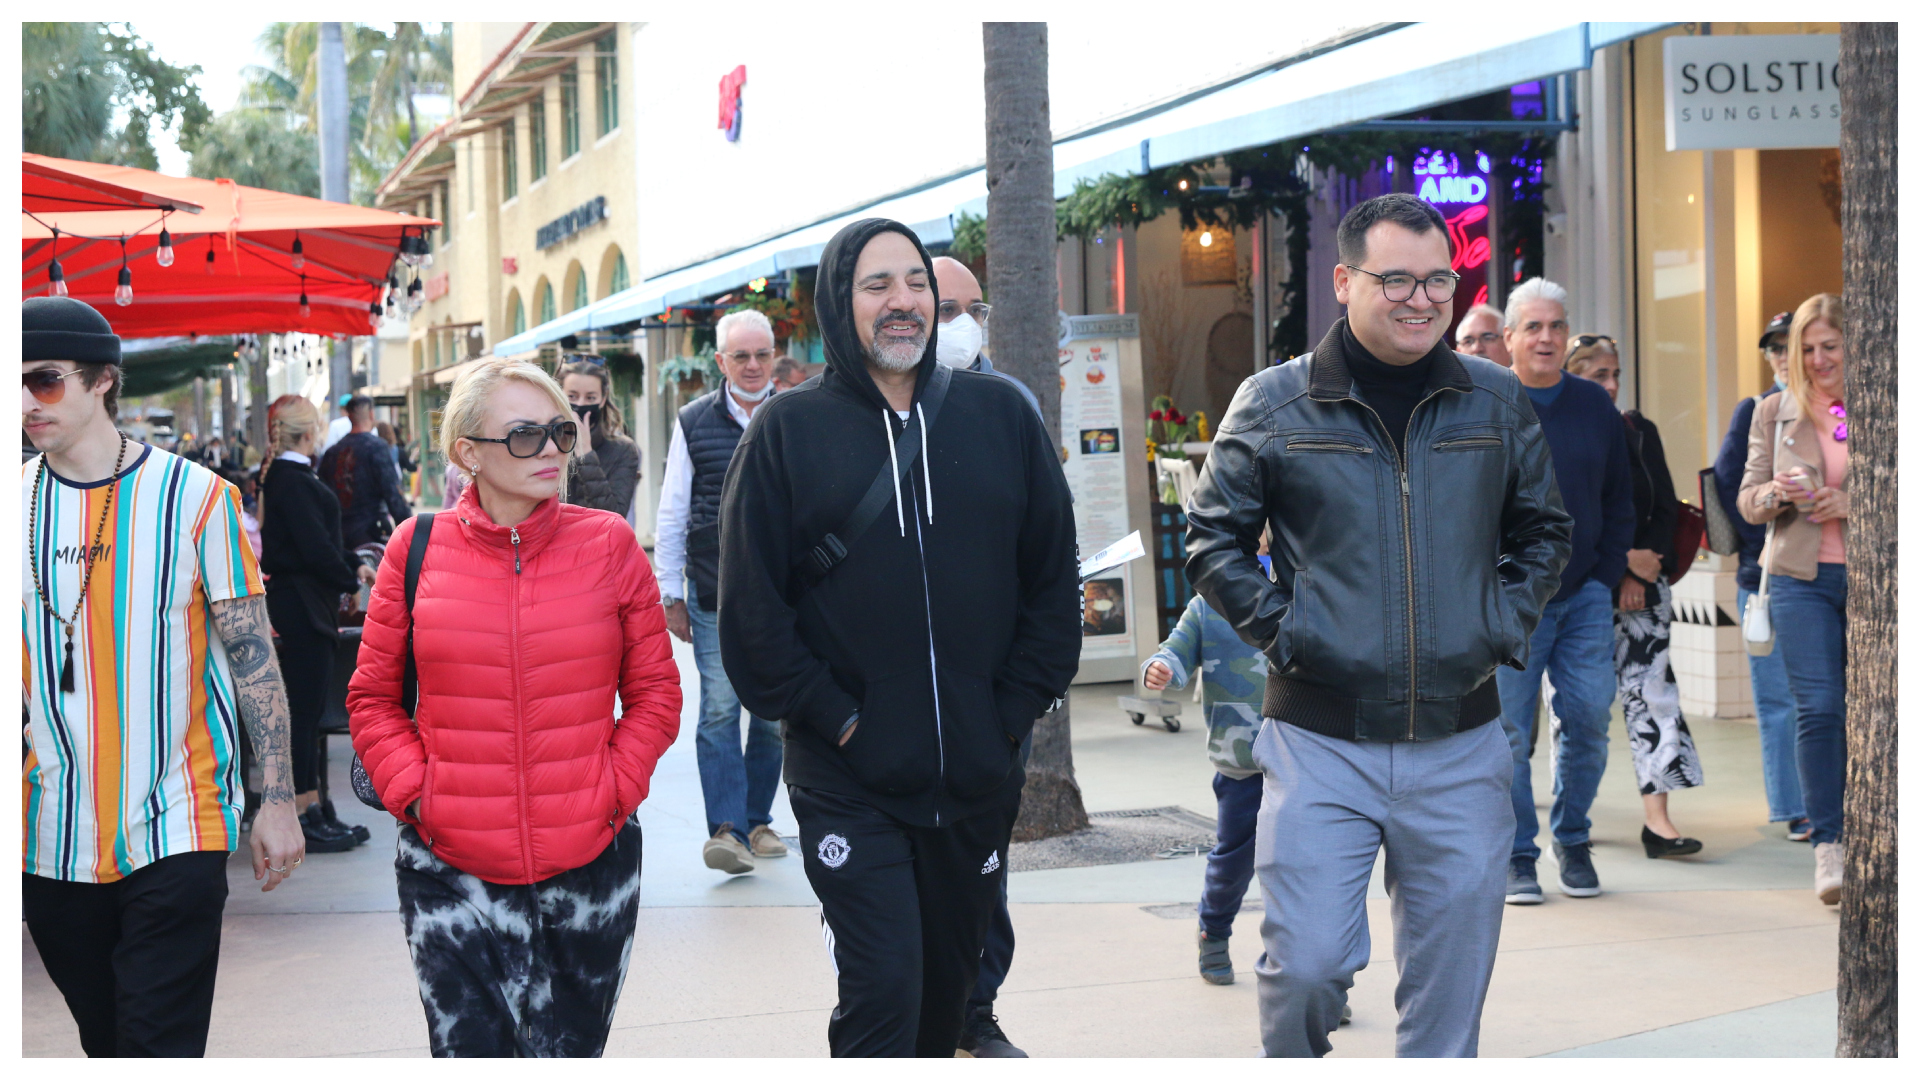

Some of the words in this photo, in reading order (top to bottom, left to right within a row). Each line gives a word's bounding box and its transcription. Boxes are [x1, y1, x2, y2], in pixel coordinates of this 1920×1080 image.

[1419, 175, 1487, 203] AND
[53, 543, 111, 565] MIAMI
[981, 861, 1000, 875] adidas
